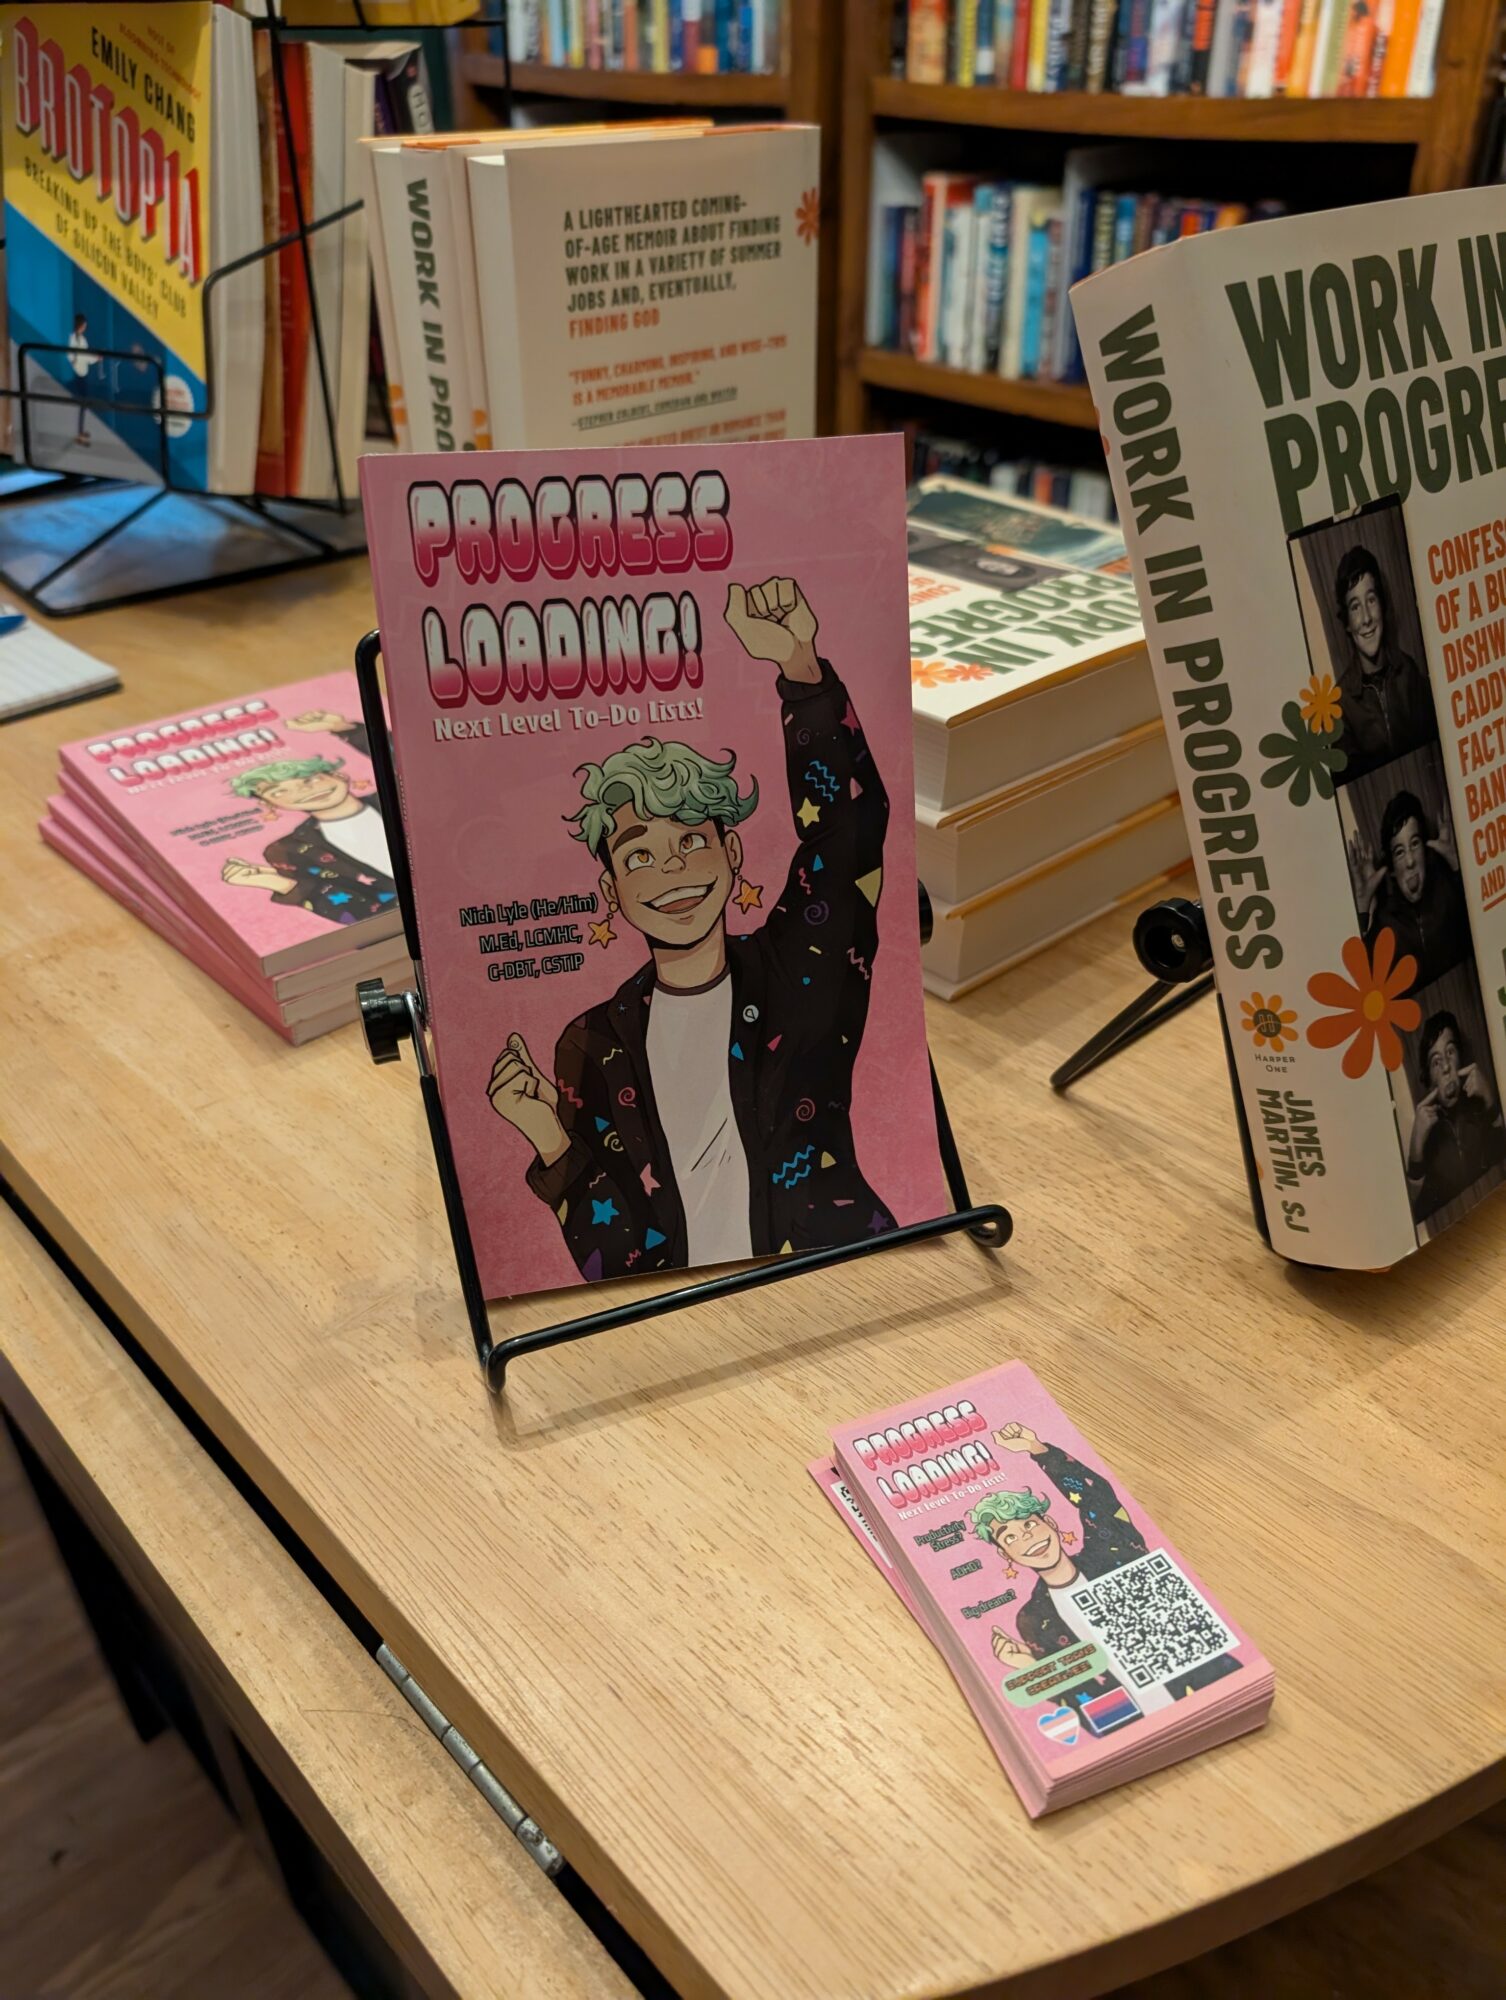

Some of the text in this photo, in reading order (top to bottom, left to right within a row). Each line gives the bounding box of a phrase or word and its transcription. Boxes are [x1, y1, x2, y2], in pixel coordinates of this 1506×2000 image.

[92, 26, 137, 90] EMILY
[144, 73, 196, 143] CHANG
[14, 16, 201, 288] BROTOPIA
[25, 156, 79, 219] BREAKING
[564, 195, 747, 231] A LIGHTHEARTED COMING-
[565, 216, 780, 259] OF-AGE MEMOIR ABOUT FINDING
[407, 178, 440, 309] WORK
[566, 241, 781, 286] WORK IN A VARIETY OF SUMMER
[567, 272, 737, 313] JOBS AND, EVENTUALLY,
[422, 320, 446, 364] IN
[569, 308, 660, 339] FINDING GOD
[1225, 243, 1453, 409] WORK
[407, 470, 733, 587] PROGRESS
[1427, 518, 1506, 585] CONFES
[1013, 592, 1138, 647] ORK
[1435, 587, 1460, 634] OF
[1469, 581, 1483, 622] A
[422, 590, 703, 708] LOADING!
[1099, 304, 1284, 970] WORK IN PROGRESS
[434, 697, 704, 741] Next Level To-Do Lists!
[1457, 716, 1506, 777] FACT
[1481, 865, 1506, 901] AND
[460, 892, 598, 927] Nich Lyle (He/Him)
[479, 924, 583, 954] M.Ed, LCMHC,
[488, 953, 584, 982] C-DBT, CSTIP
[1283, 1091, 1326, 1177] JAMES
[1256, 1088, 1310, 1233] MARTIN, SJ
[853, 1400, 987, 1471] PROGRESS
[877, 1440, 1000, 1509] LOADING!
[897, 1505, 923, 1521] Next
[924, 1495, 951, 1511] Level
[953, 1485, 981, 1501] To-Do
[913, 1520, 966, 1547] Productivity
[929, 1532, 964, 1552] Stress?
[950, 1559, 983, 1580] ADHD?
[961, 1588, 1017, 1620] Big dreams?
